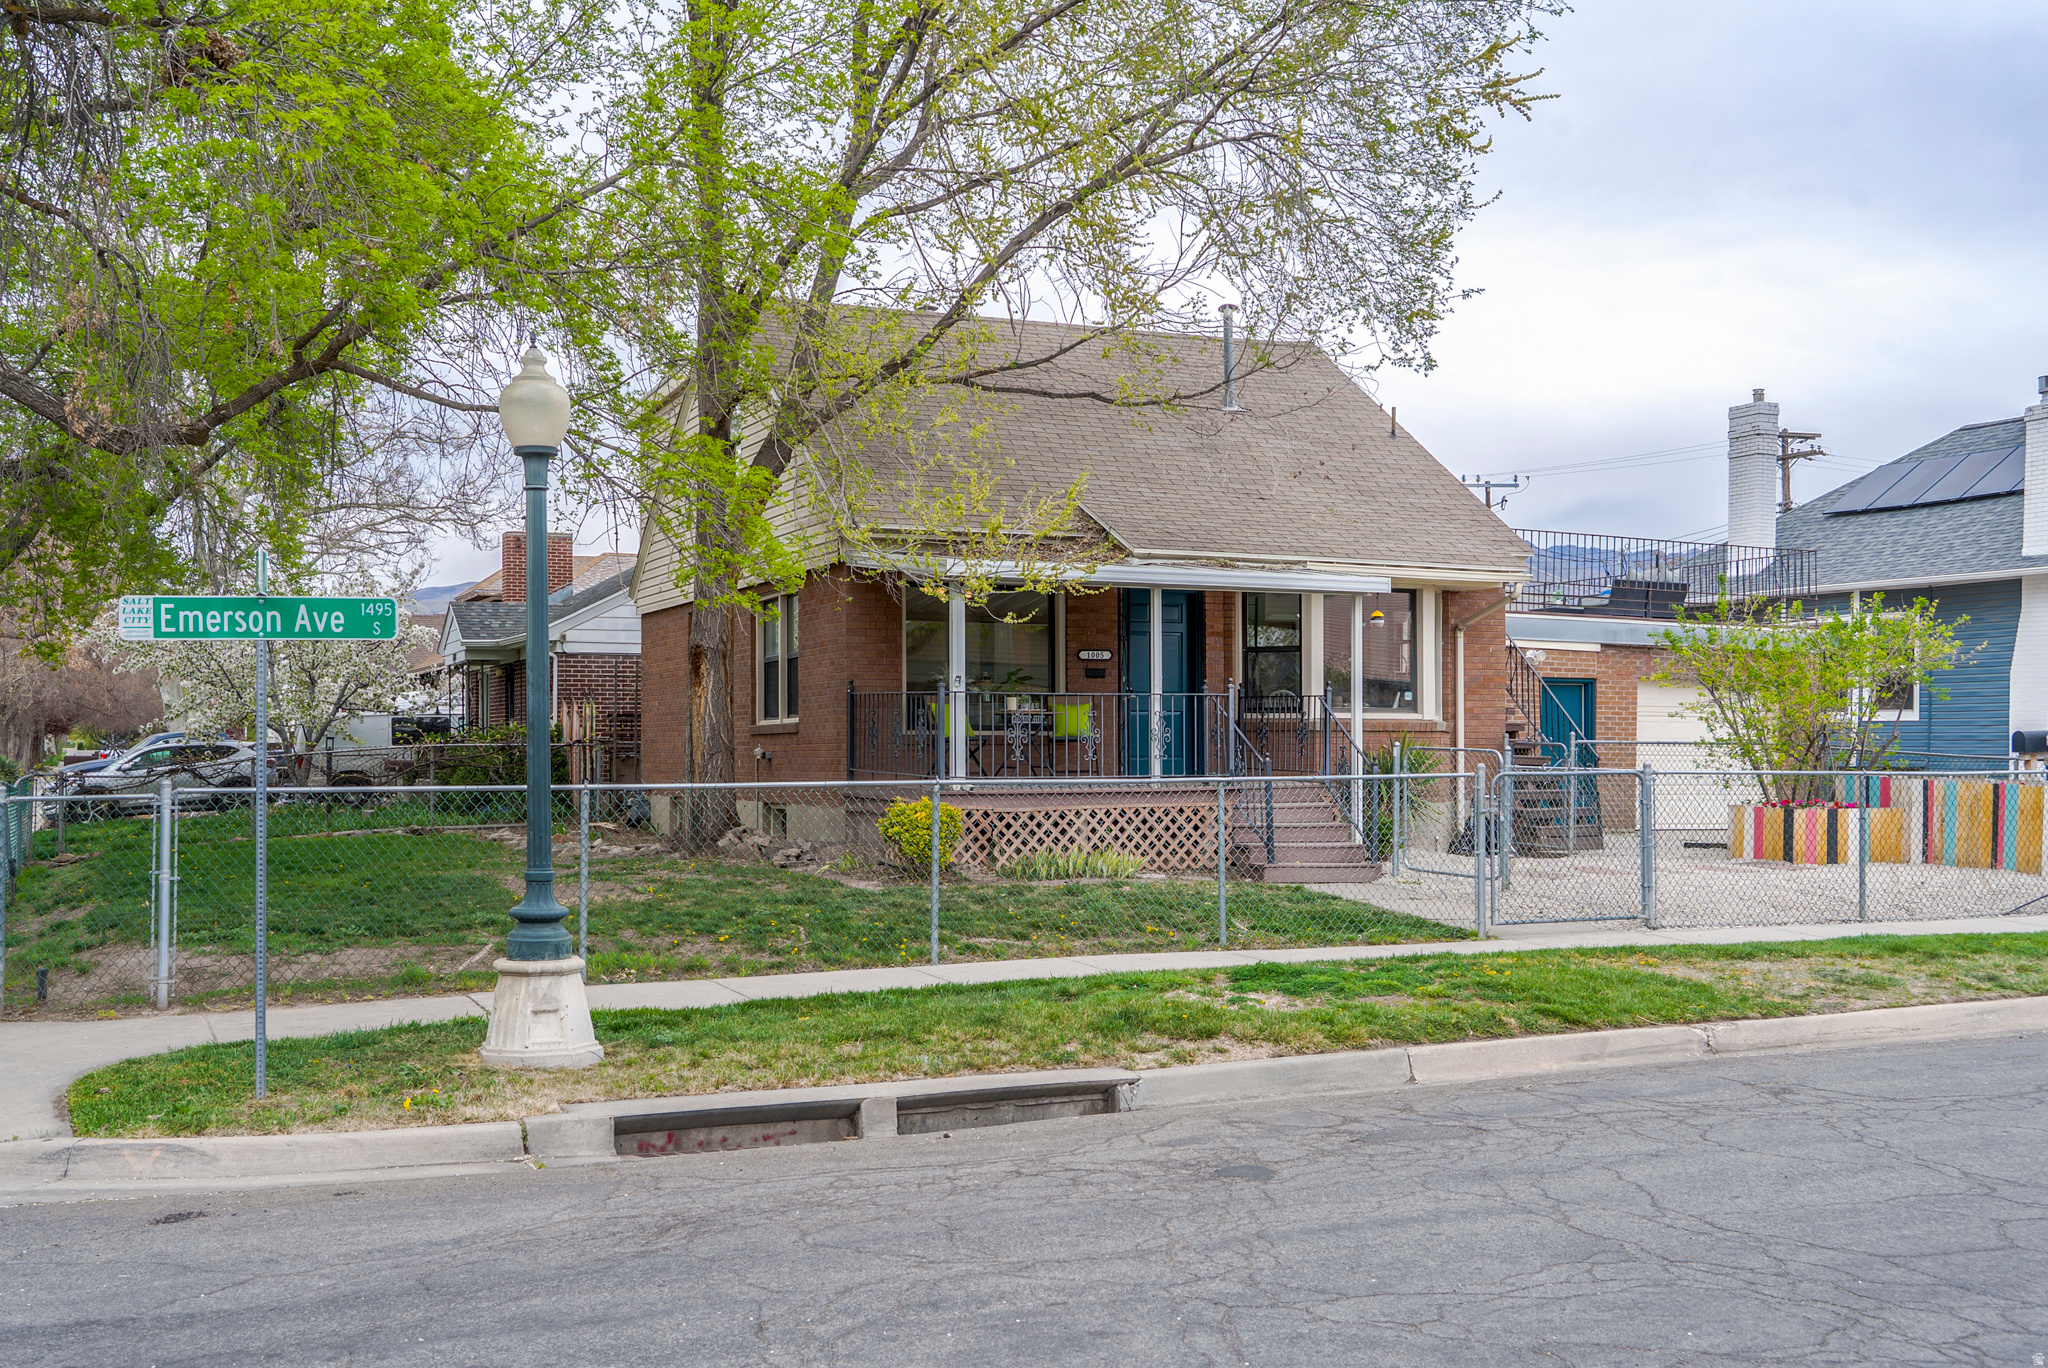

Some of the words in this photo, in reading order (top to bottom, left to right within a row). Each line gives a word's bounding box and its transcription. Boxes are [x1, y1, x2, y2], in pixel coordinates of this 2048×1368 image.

[122, 597, 152, 605] SALT
[122, 607, 152, 615] LAKE
[361, 602, 393, 617] 1495
[123, 616, 152, 624] CITY
[160, 603, 282, 633] Emerson
[294, 603, 345, 633] Ave
[372, 621, 381, 636] S
[1086, 651, 1105, 659] 1005
